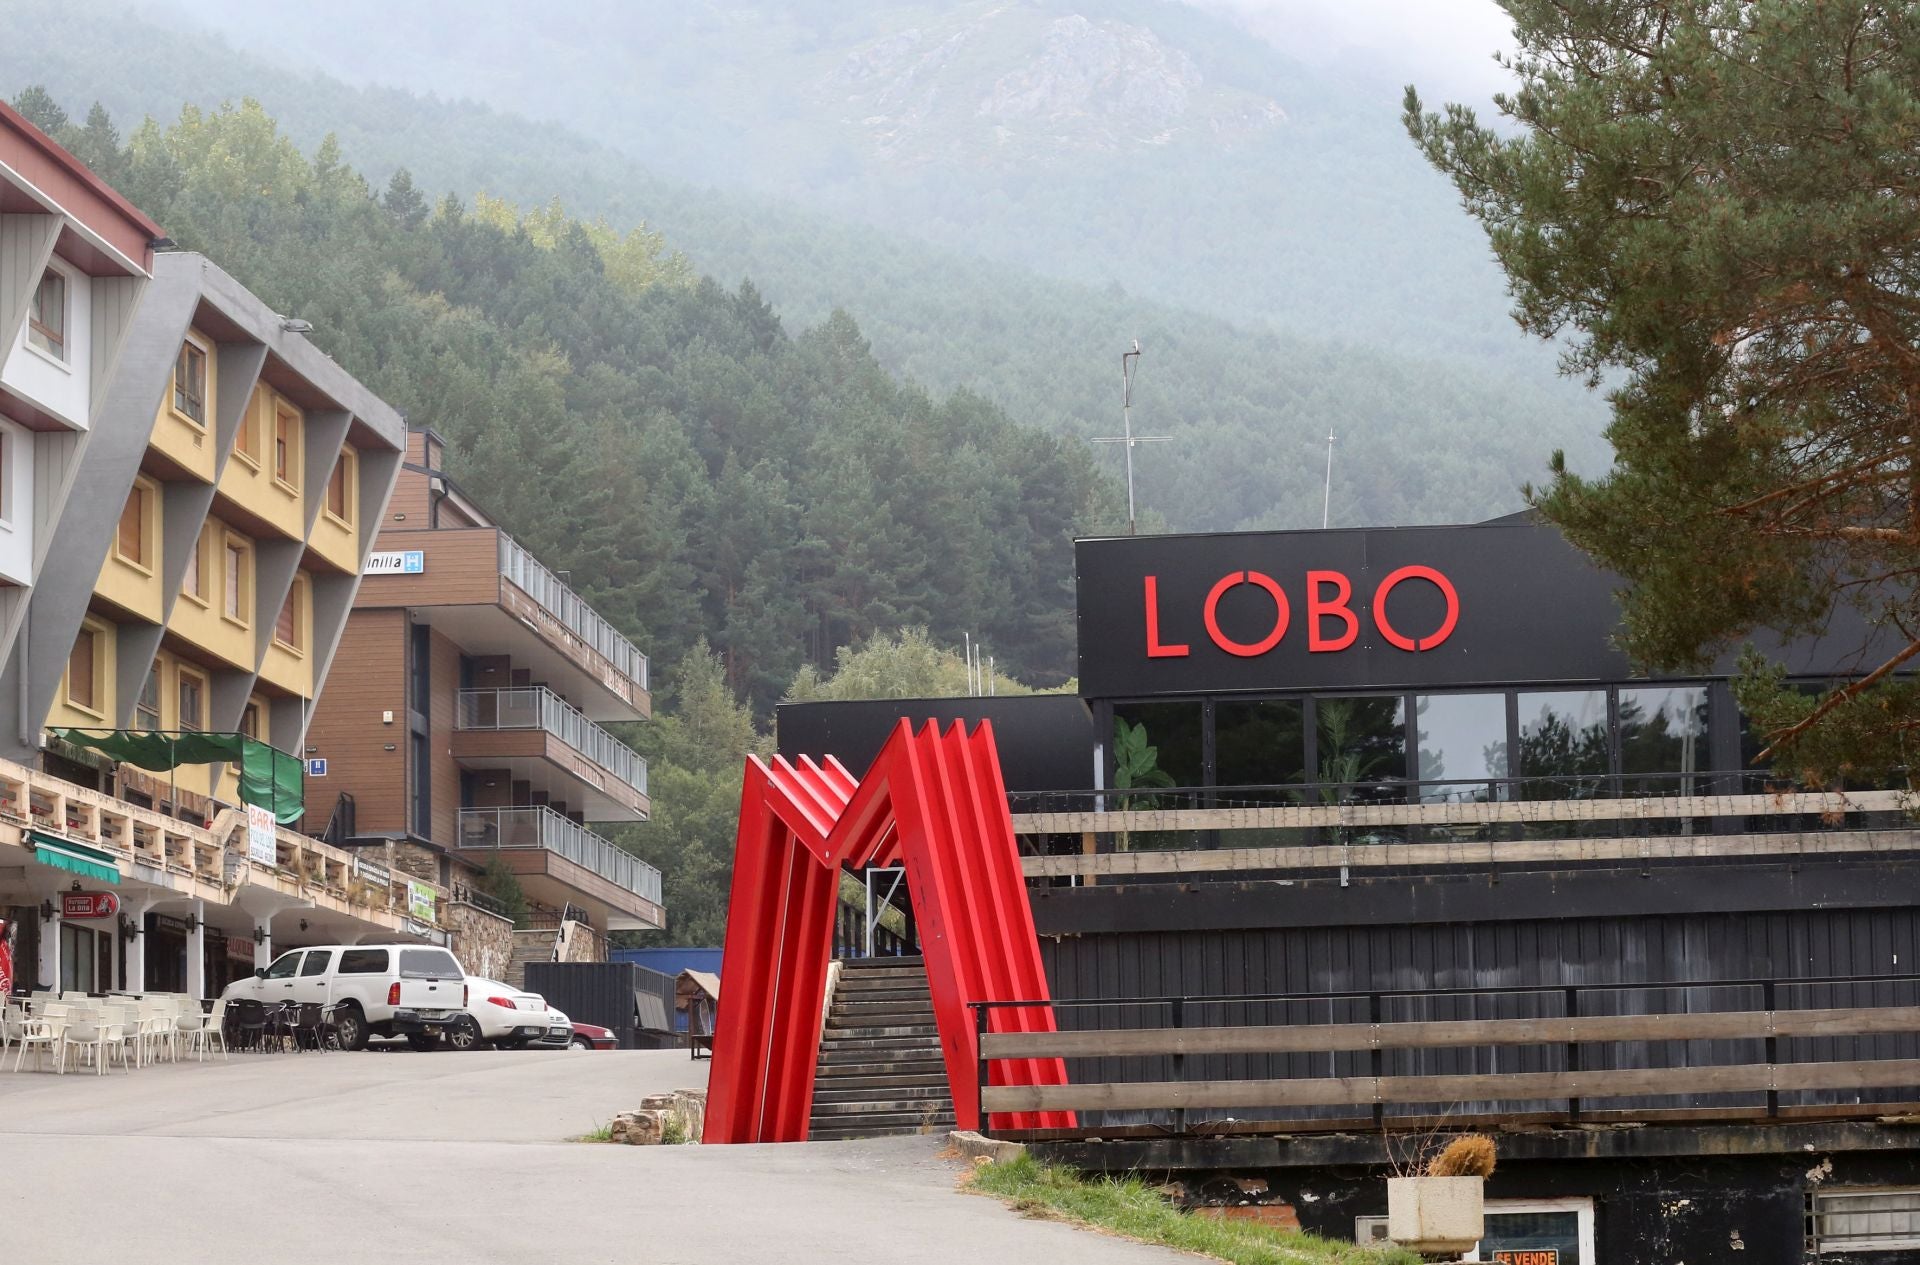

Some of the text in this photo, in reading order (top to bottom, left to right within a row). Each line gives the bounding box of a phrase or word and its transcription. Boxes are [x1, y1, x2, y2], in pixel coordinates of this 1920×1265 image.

[366, 555, 402, 569] inilla
[1144, 564, 1460, 658] LOBO
[250, 807, 269, 830] BAR
[1514, 1252, 1555, 1265] VENDE
